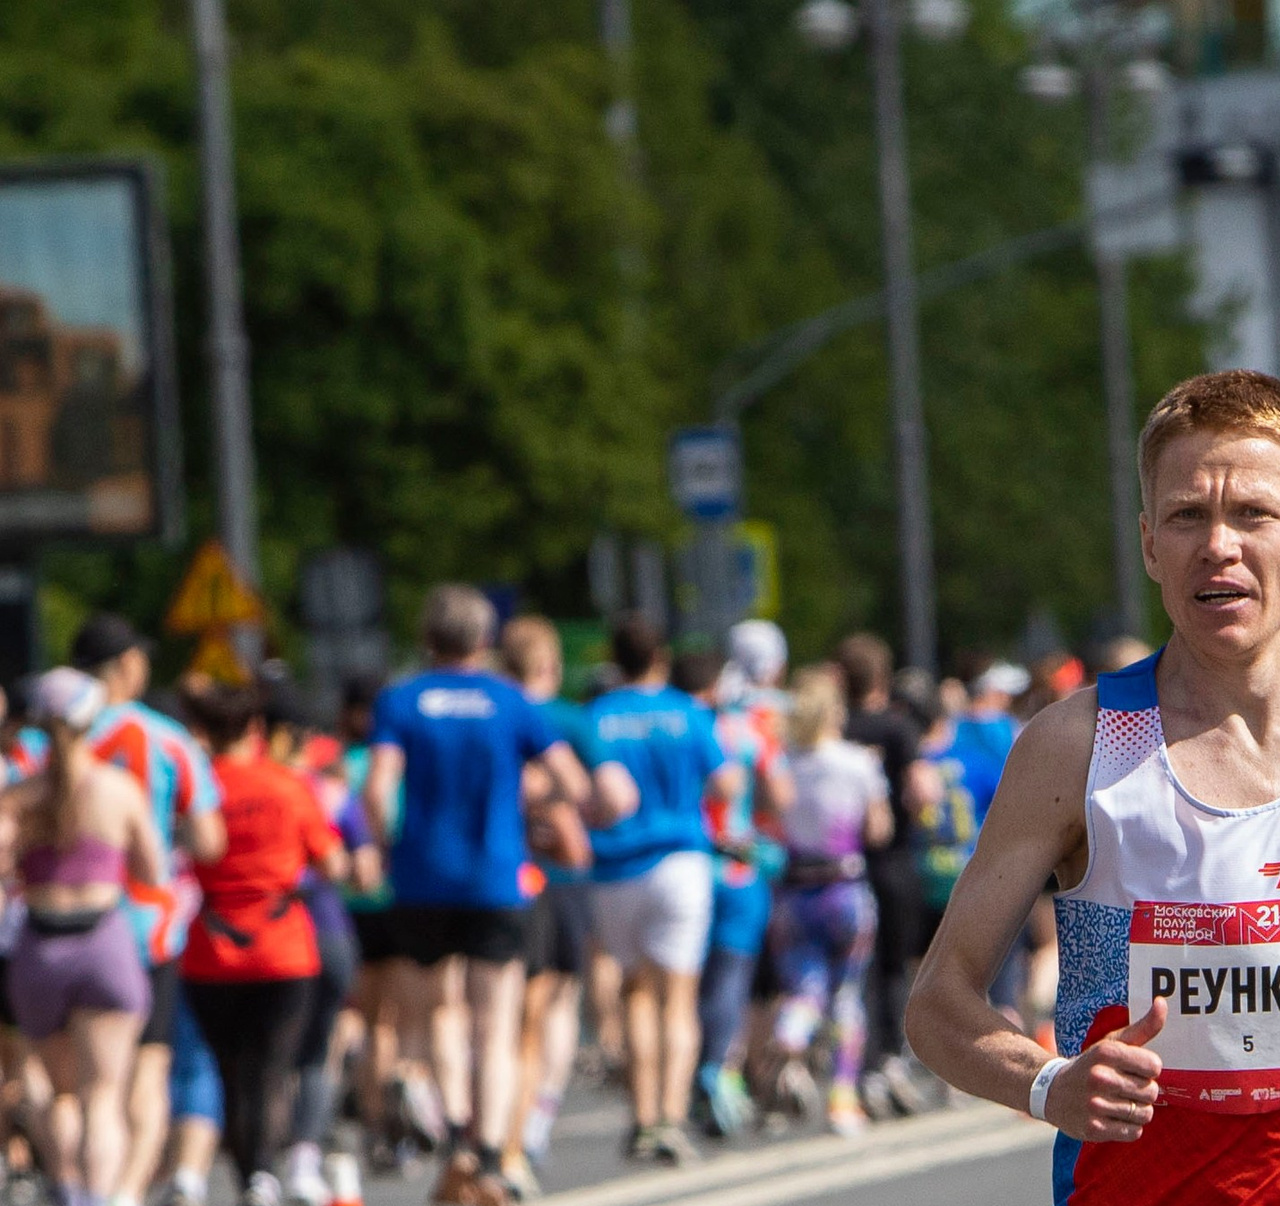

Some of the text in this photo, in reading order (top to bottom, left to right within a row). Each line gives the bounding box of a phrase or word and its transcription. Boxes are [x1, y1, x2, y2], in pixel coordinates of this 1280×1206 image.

[1154, 905, 1237, 918] МОСКОВСКИЙ
[1153, 928, 1213, 940] МАРАФОН
[1242, 1035, 1254, 1053] 5
